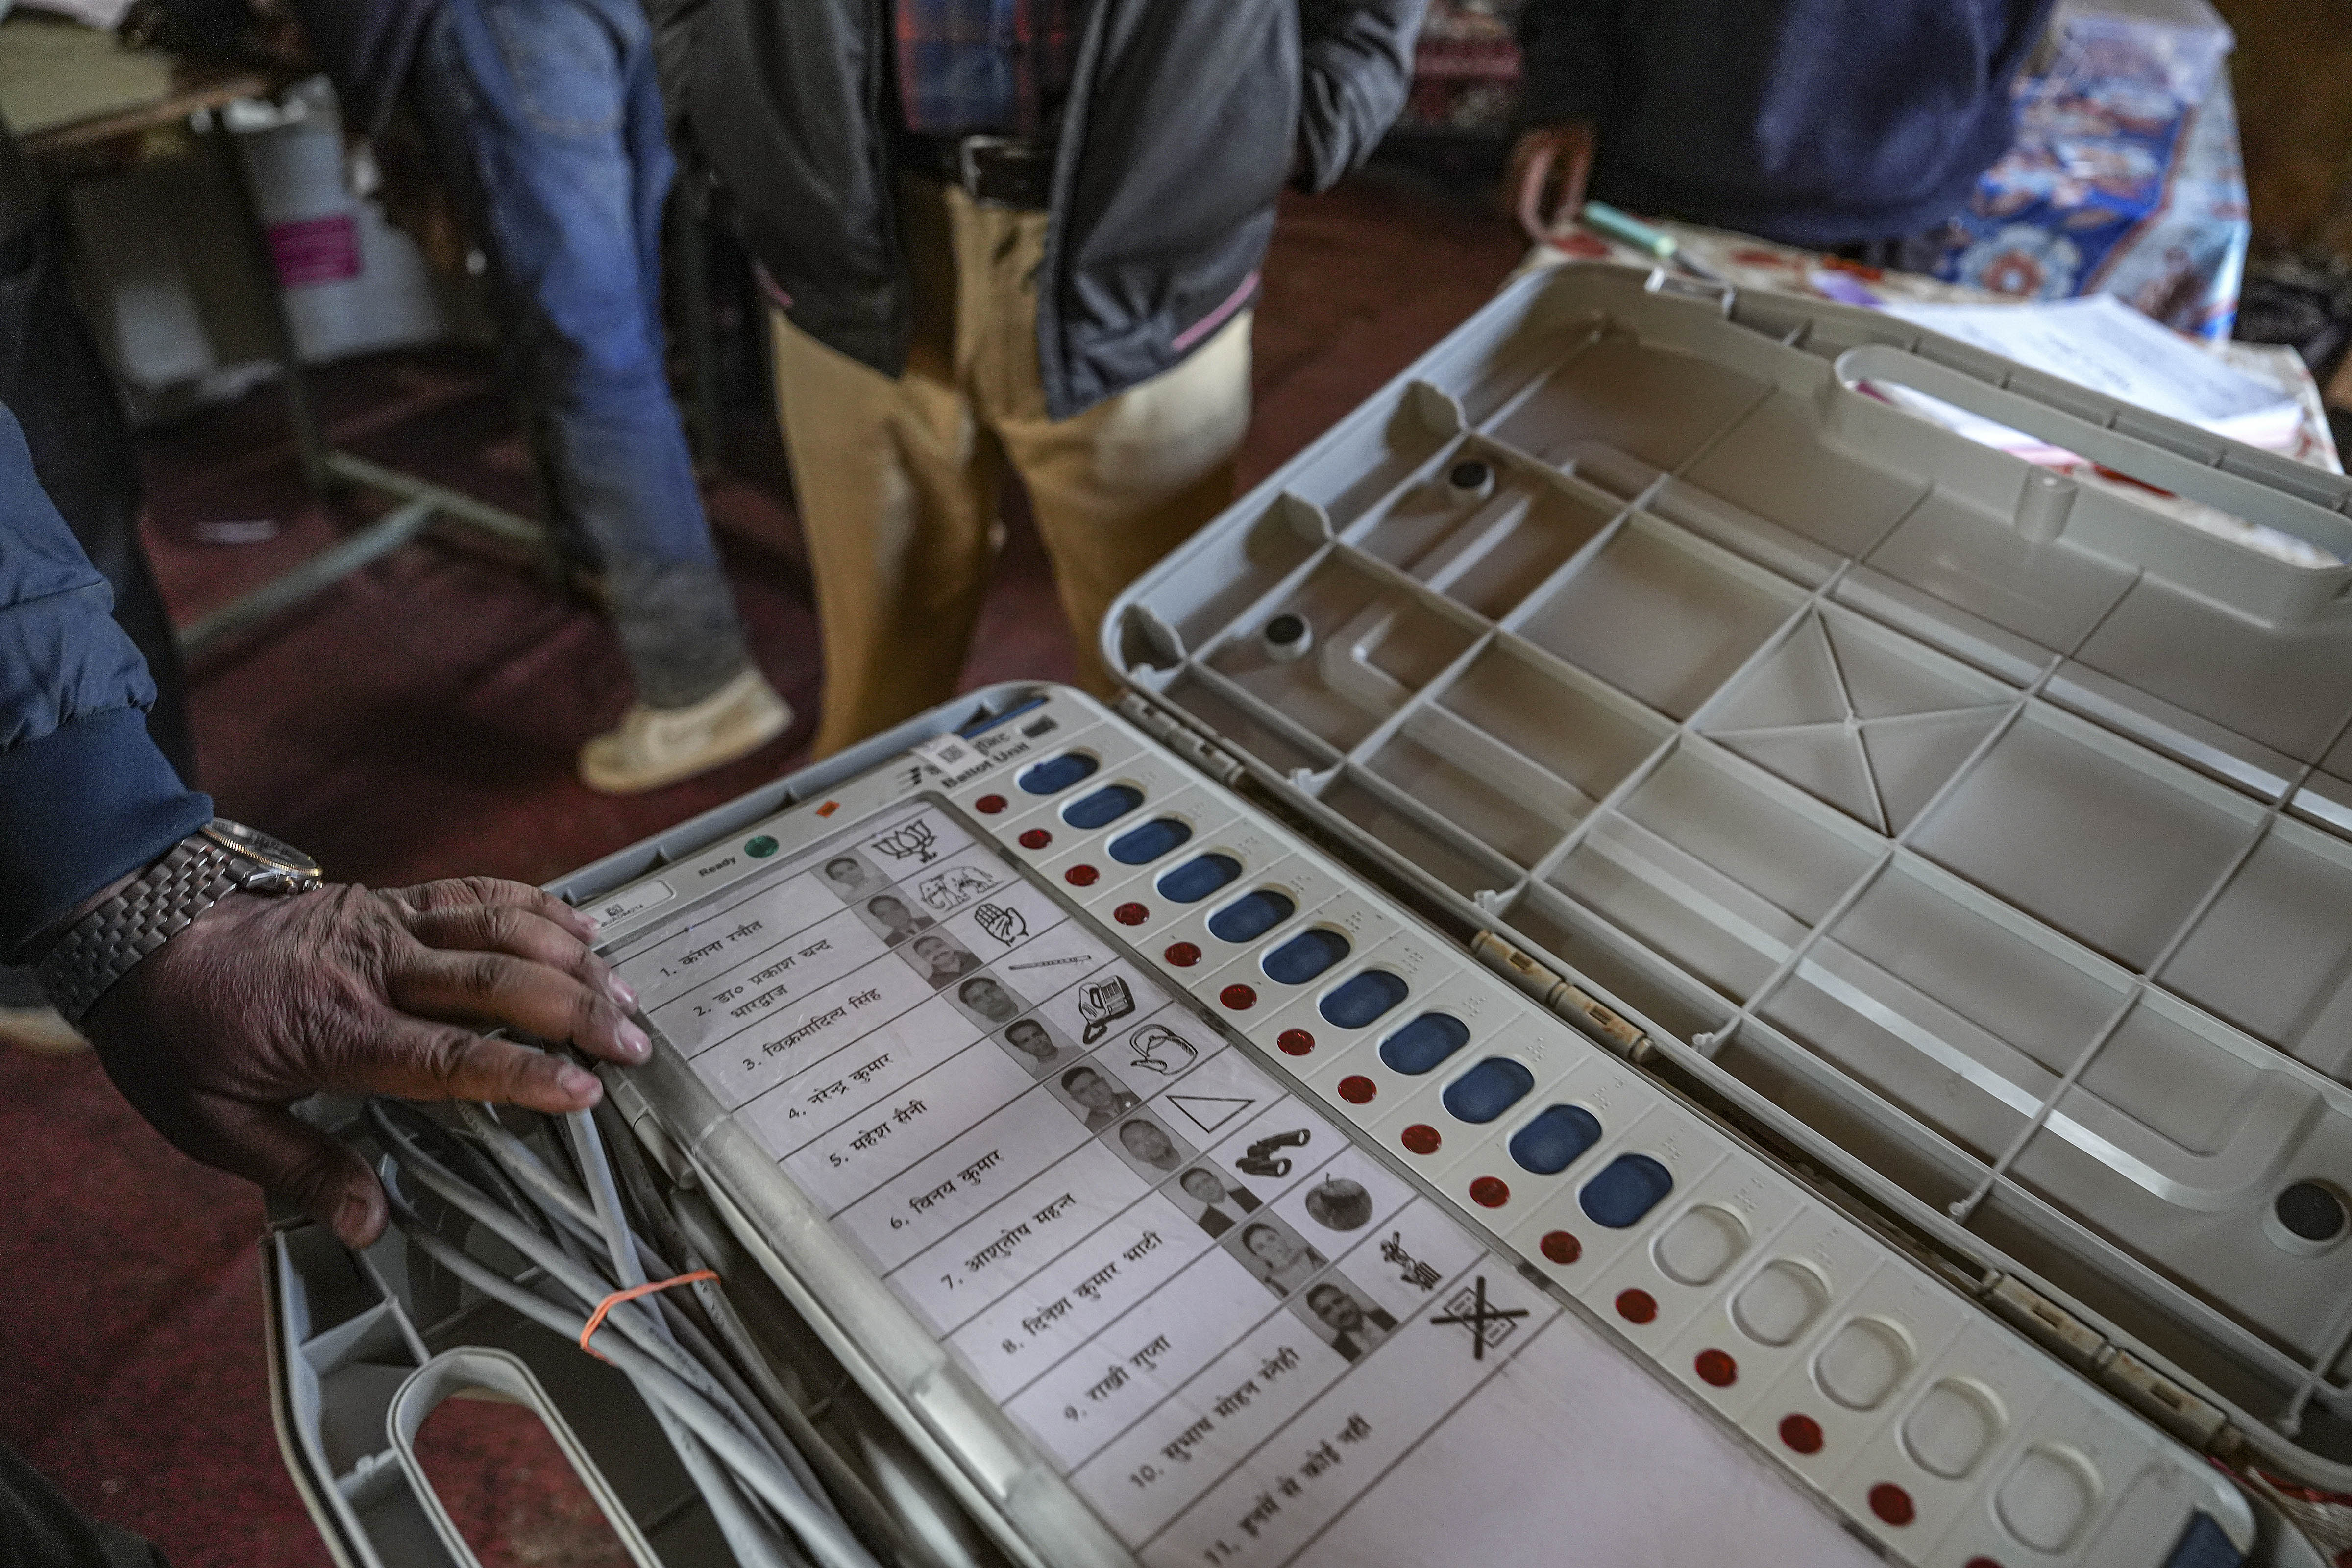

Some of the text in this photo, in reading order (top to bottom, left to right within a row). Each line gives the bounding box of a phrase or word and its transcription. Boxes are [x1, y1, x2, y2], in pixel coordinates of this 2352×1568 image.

[698, 857, 736, 877] Ready
[660, 920, 763, 977] 1. कंगना रनौत
[693, 1006, 712, 1017] 2.
[747, 956, 796, 984] प्रकाश
[798, 938, 833, 957] चन्द
[731, 984, 787, 1017] भारद्वाज
[743, 988, 881, 1071] 3. विक्रमादित्य सिंह
[789, 1053, 894, 1119] 4. नरेन्द्र कुमार
[830, 1100, 928, 1167] 5. महेश सैनी
[890, 1149, 1004, 1229] 6. विनय कुमार
[940, 1192, 1076, 1291] 7. आशुतोष महन्त
[1002, 1230, 1163, 1354] 8. दिनेश कुमार भाटी
[1063, 1334, 1172, 1421] 9. राखी गुप्ता
[1130, 1464, 1165, 1488] 10.
[1161, 1416, 1215, 1462] सुभाष
[1213, 1379, 1261, 1418] मोहन
[1203, 1540, 1241, 1566] 11.
